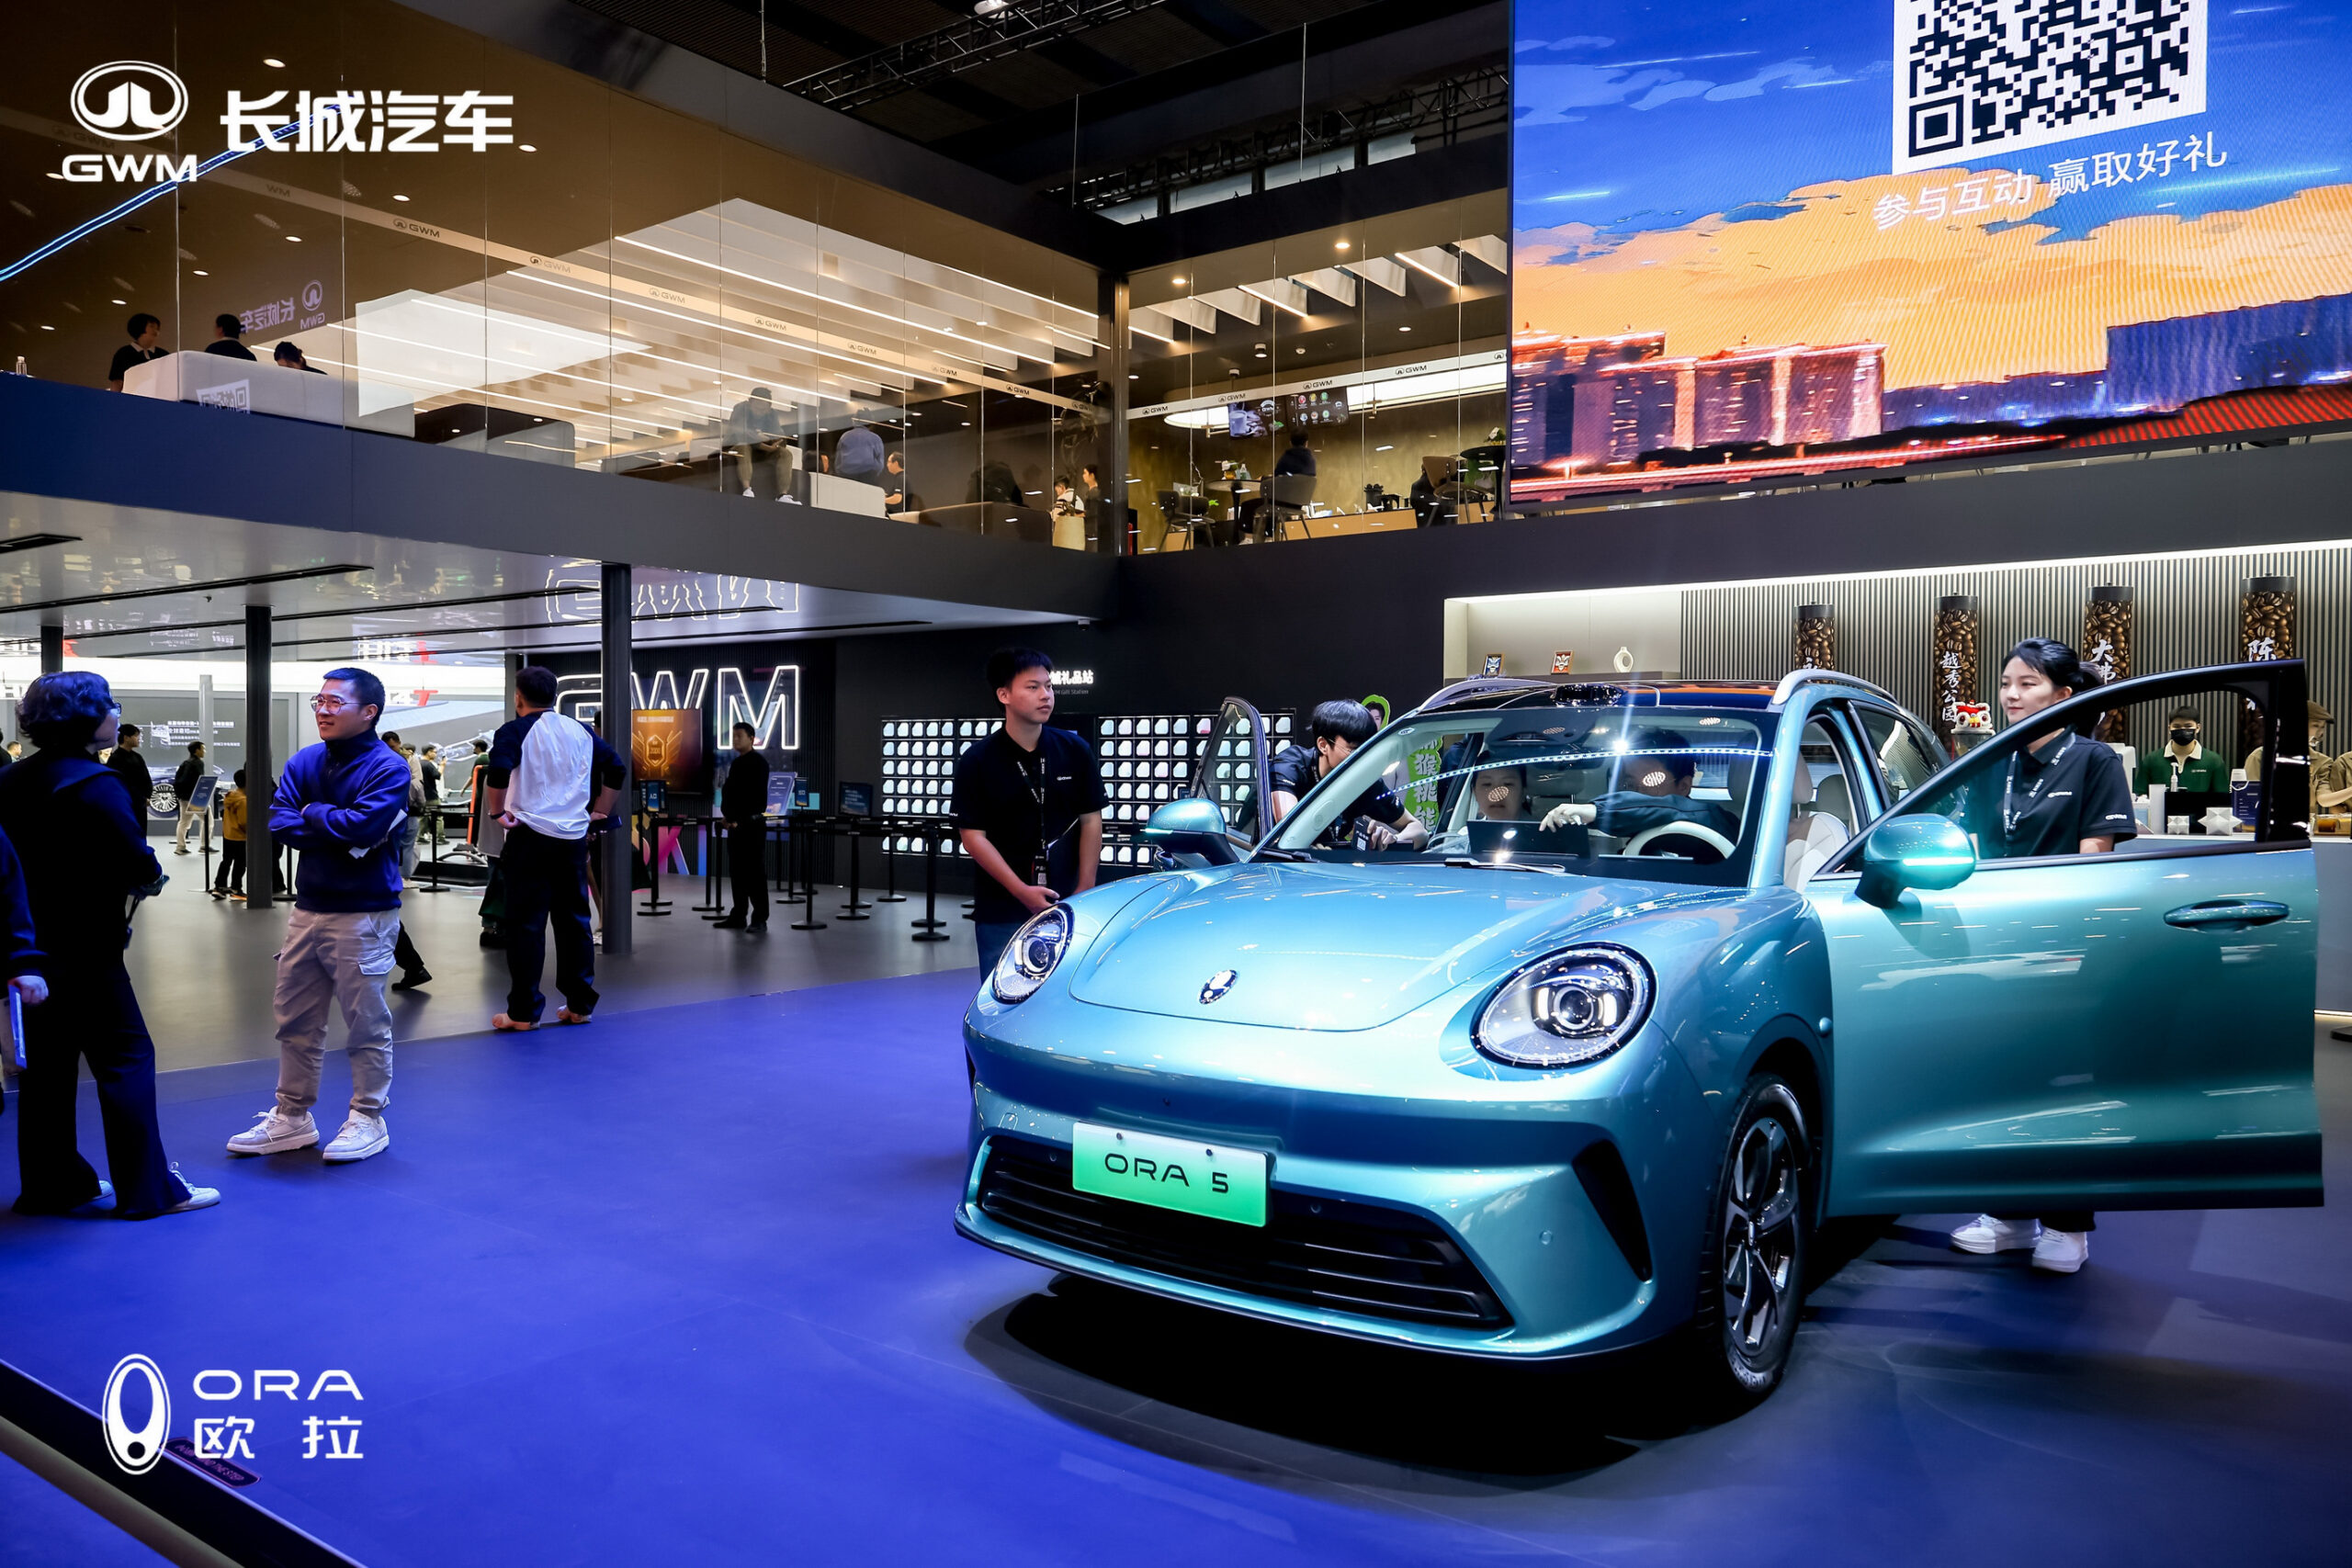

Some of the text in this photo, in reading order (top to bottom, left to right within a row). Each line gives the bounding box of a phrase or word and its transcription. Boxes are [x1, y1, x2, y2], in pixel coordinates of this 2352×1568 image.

[1872, 130, 2228, 231] 参与互动 赢取好礼
[408, 222, 440, 239] GWM
[544, 260, 571, 274] GWM
[661, 291, 685, 304] GWM
[764, 320, 787, 332] GWM
[857, 344, 877, 355] GWM
[940, 367, 957, 377] GWM
[1405, 365, 1428, 374] GWM
[1312, 379, 1333, 389] GWM
[1014, 387, 1030, 396] GWM
[1227, 393, 1246, 402] GWM
[1150, 405, 1169, 414] GWM
[1939, 651, 1962, 723] 越秀公园
[1104, 1153, 1229, 1193] ORA 5
